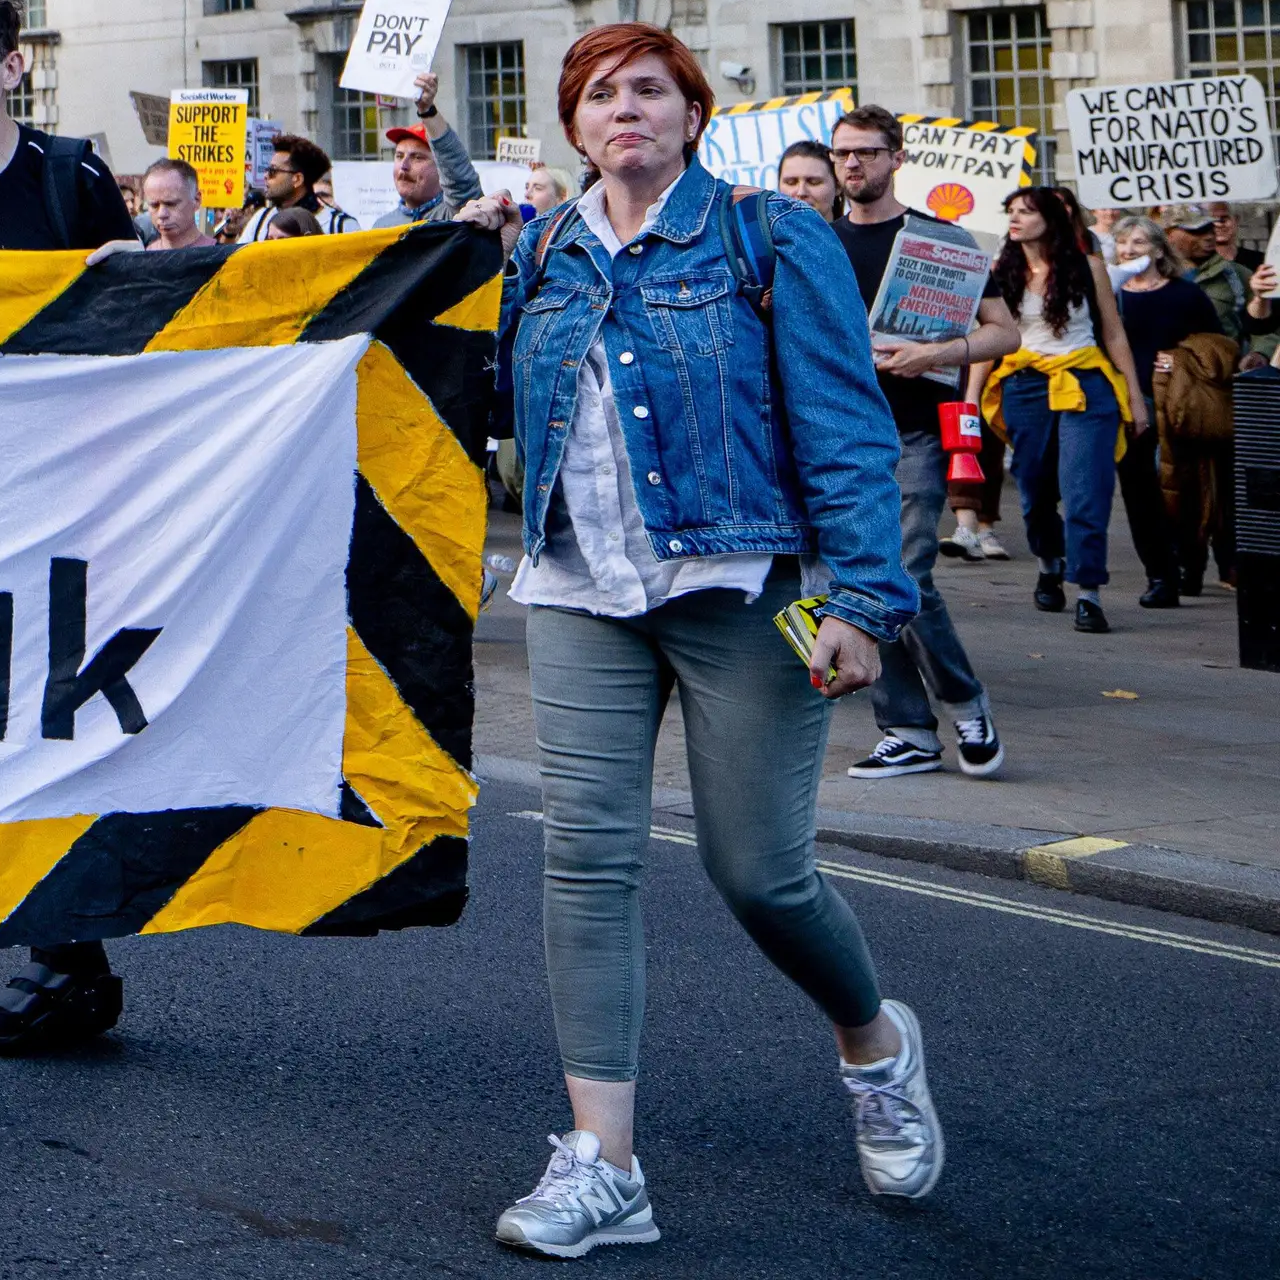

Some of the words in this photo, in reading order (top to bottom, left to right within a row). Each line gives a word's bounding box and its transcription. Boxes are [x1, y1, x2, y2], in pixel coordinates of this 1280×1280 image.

[373, 14, 429, 32] DON'T
[366, 30, 423, 56] PAY
[180, 92, 209, 101] Socialist
[210, 92, 237, 101] Worker
[1080, 90, 1120, 114] WE
[1203, 78, 1248, 106] PAY
[176, 105, 240, 124] SUPPORT
[1090, 115, 1145, 145] FOR
[1151, 106, 1258, 141] NATO'S
[193, 125, 219, 143] THE
[703, 100, 844, 168] RITISH
[969, 132, 1021, 156] PAY
[177, 144, 235, 163] STRIKES
[1078, 137, 1264, 176] MANUFACTURED
[963, 157, 1015, 180] PAY
[1109, 170, 1230, 202] CRISIS
[931, 244, 987, 270] Socialist
[894, 267, 905, 278] TO
[904, 270, 920, 282] CUT
[920, 273, 937, 285] OUR
[936, 278, 956, 291] BILLS
[897, 257, 919, 270] SEIZE
[919, 262, 941, 275] THEIR
[940, 267, 967, 282] PROFITS
[899, 296, 945, 317] ENERGY
[909, 284, 976, 312] NATIONALISE
